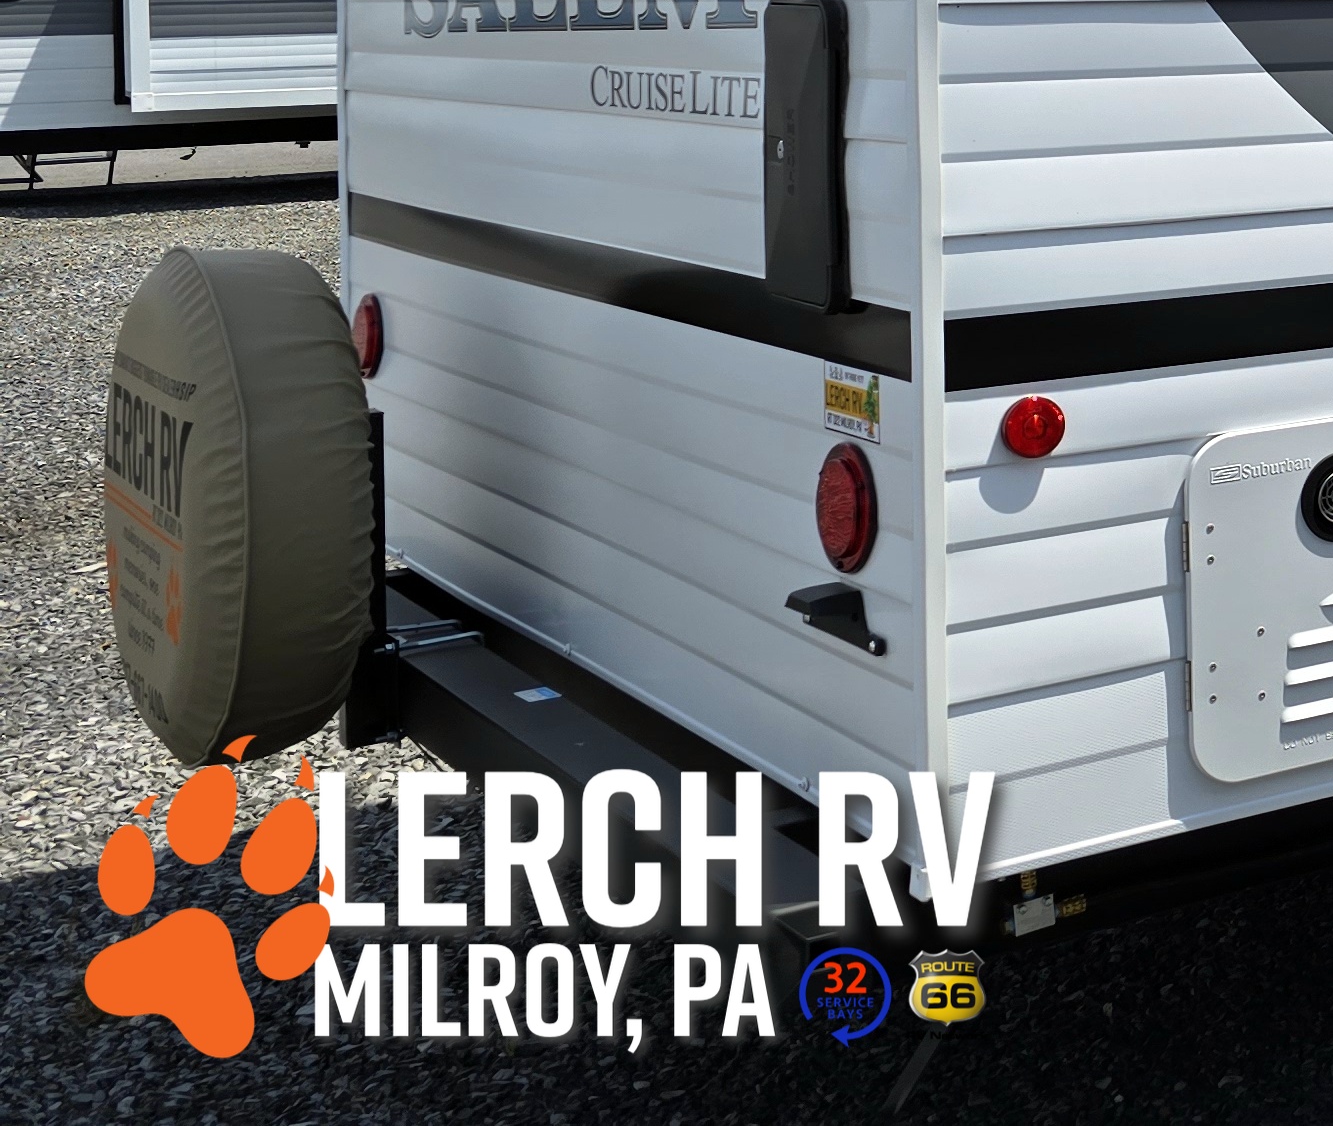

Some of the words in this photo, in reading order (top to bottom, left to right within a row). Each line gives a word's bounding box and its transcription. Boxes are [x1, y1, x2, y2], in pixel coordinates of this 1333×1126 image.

[105, 382, 156, 501] LERCH
[159, 410, 194, 519] RV
[1241, 457, 1312, 480] Suburban
